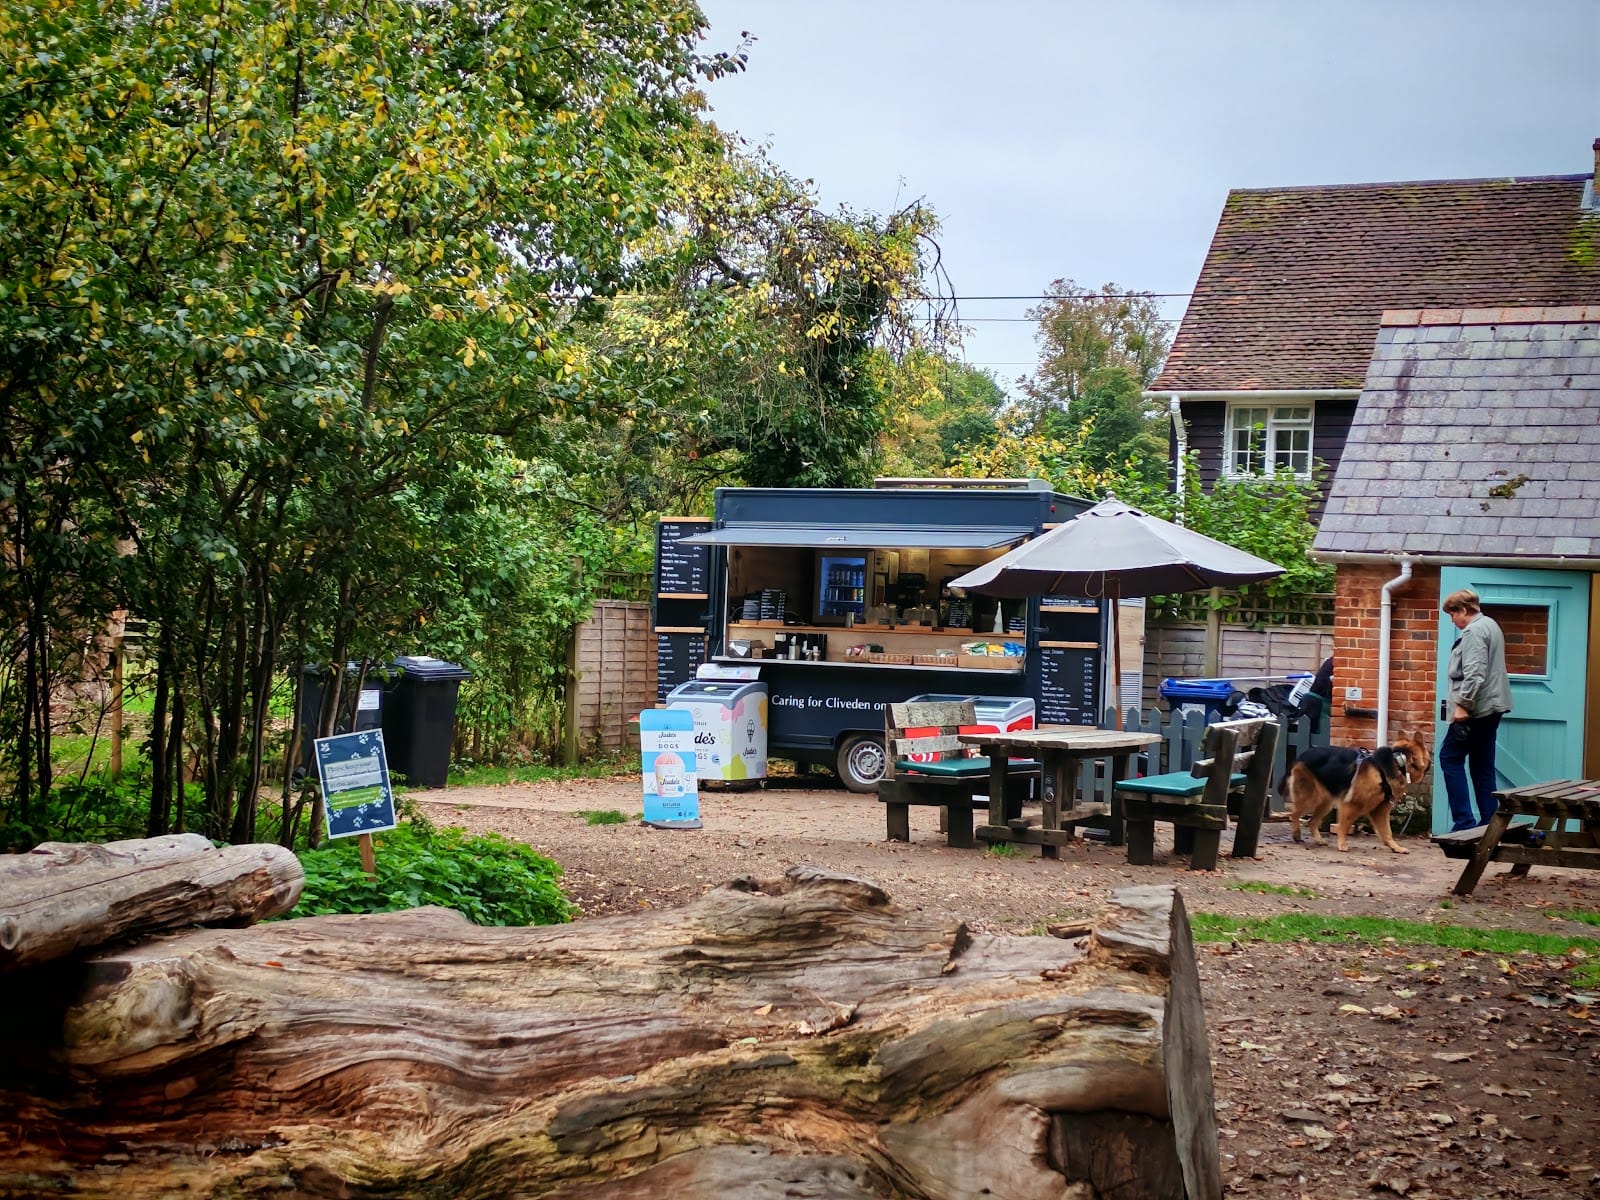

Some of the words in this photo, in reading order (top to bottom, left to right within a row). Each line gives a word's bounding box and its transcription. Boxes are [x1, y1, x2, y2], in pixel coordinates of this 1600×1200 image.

[771, 694, 805, 709] Caring
[807, 695, 823, 707] for
[825, 697, 871, 710] Cliveden
[694, 731, 716, 745] de's
